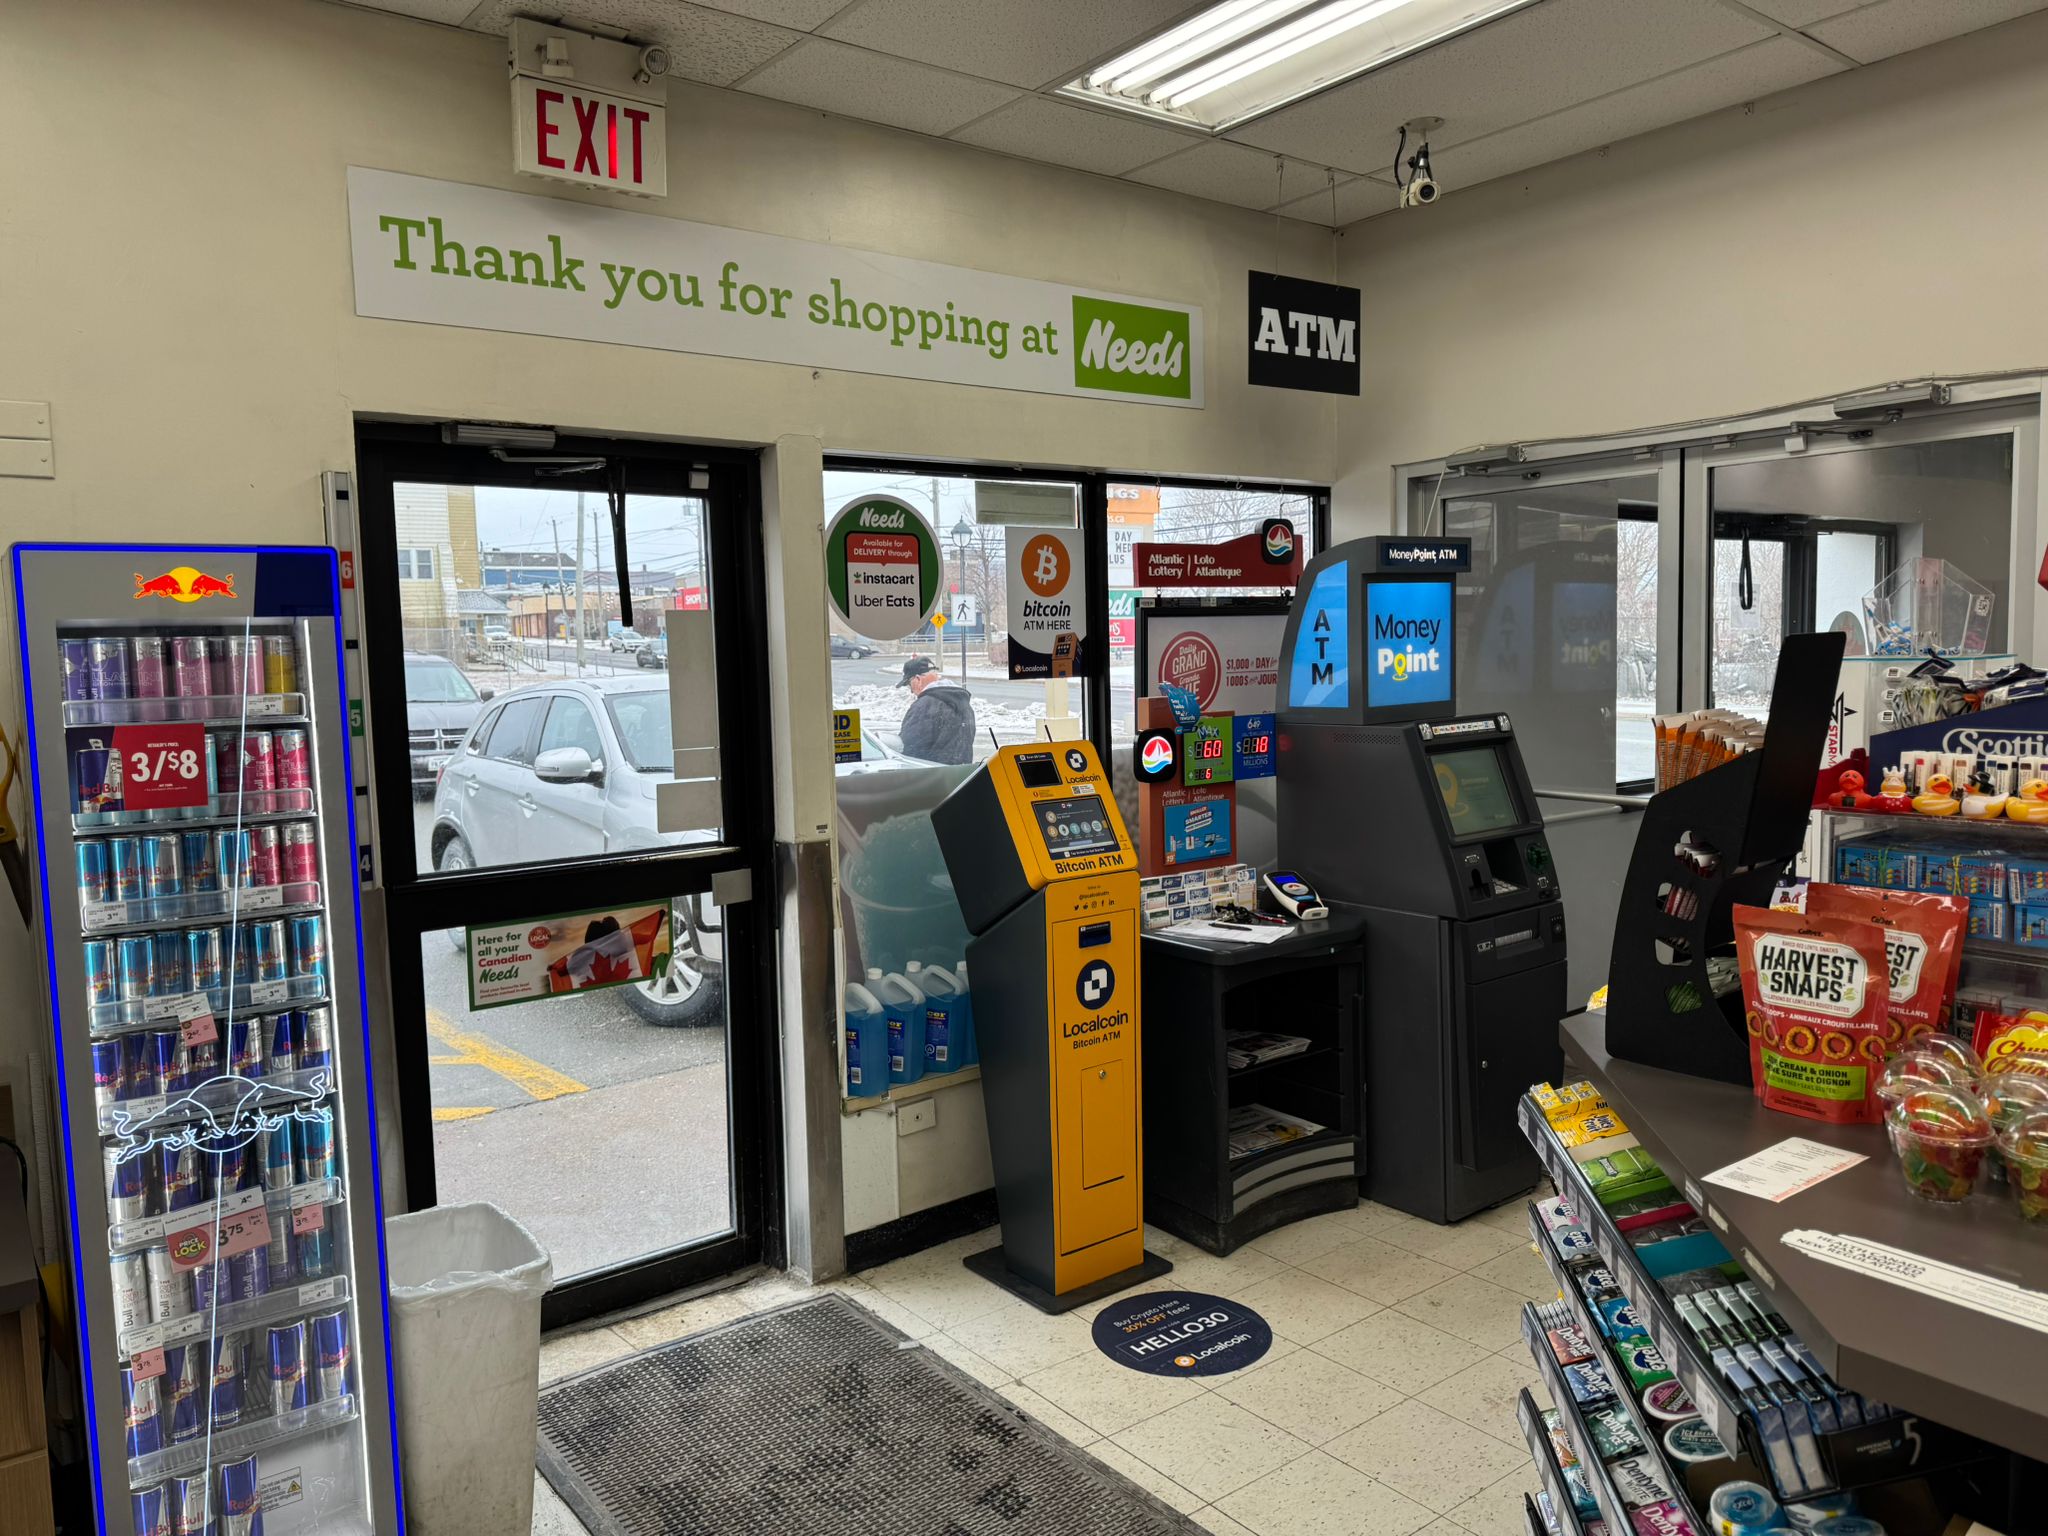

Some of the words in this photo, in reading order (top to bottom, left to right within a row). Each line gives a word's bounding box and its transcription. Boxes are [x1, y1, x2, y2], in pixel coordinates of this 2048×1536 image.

[536, 88, 650, 184] EXIT
[379, 215, 585, 292] Thank
[600, 260, 704, 309] you
[718, 262, 793, 320] for
[808, 277, 1010, 359] shopping
[1021, 322, 1058, 355] at
[1254, 307, 1356, 363] ATM
[1080, 317, 1183, 379] Needs
[860, 508, 905, 528] Needs
[863, 539, 892, 547] Available
[854, 548, 885, 556] DELIVERY
[888, 550, 912, 558] through
[1149, 554, 1184, 564] Atlantic
[1194, 554, 1215, 565] Loto
[1439, 549, 1457, 559] ATM
[341, 561, 352, 579] 6
[863, 572, 914, 584] instacart
[1149, 566, 1183, 579] Lottery
[1195, 567, 1242, 579] Atlantique
[854, 595, 884, 607] Uber
[886, 595, 915, 607] Eats
[1023, 600, 1071, 617] bitcoin
[1024, 620, 1044, 630] ATM
[1047, 620, 1071, 630] HERE
[1375, 614, 1440, 645] Money
[1180, 644, 1197, 655] Daily
[1312, 609, 1333, 685] ATM
[1022, 664, 1048, 672] Localcoin
[1172, 650, 1207, 675] GRAND
[1226, 659, 1249, 670] $1,000
[1255, 657, 1270, 669] DAY
[1378, 645, 1439, 678] Point
[1257, 674, 1277, 685] JOUR
[351, 709, 361, 726] 5
[1198, 726, 1219, 739] MAX
[1203, 740, 1222, 758] 60
[1255, 736, 1269, 753] 18
[1944, 729, 2048, 756] Scotti
[131, 749, 199, 782] 3/$8
[1205, 768, 1212, 779] 6
[1065, 774, 1101, 784] Localcoin
[1162, 790, 1186, 798] Atlantic
[361, 855, 371, 873] 4
[1055, 859, 1096, 874] Bitcoin
[1099, 854, 1124, 868] ATM
[477, 935, 503, 946] Here
[506, 932, 522, 943] for
[530, 935, 549, 943] LOCAL
[477, 946, 492, 957] all
[495, 944, 520, 957] your
[478, 952, 533, 968] Canadian
[1761, 945, 1858, 984] HARVEST
[479, 965, 520, 983] Needs
[1770, 972, 1842, 1003] SNAPS
[1063, 1010, 1129, 1038] Localcoin
[1789, 1013, 1822, 1024] ANNEAUX
[1822, 1019, 1879, 1031] CROUSTILLANTS
[1073, 1034, 1101, 1050] Bitcoin
[1102, 1030, 1120, 1042] ATM
[1779, 1061, 1807, 1073] CREAM
[1818, 1069, 1848, 1078] ONION
[1782, 1069, 1803, 1080] SURE
[1816, 1077, 1851, 1087] OIGNON
[174, 1242, 207, 1258] LOCK
[179, 1237, 200, 1249] PRICE
[1797, 1238, 1825, 1249] NEW
[1827, 1248, 1917, 1278] REGULATIONS
[1817, 1235, 1867, 1255] HEALTH
[1870, 1251, 1926, 1272] CANADA
[1829, 1243, 1854, 1256] HAS
[1859, 1252, 1923, 1275] ADOPTED
[1594, 1269, 1618, 1288] excel
[1113, 1318, 1131, 1329] Buy
[1130, 1307, 1159, 1322] Crypto
[1158, 1299, 1180, 1310] Here
[1122, 1319, 1147, 1334] 30%
[1147, 1313, 1167, 1325] OFF
[1130, 1312, 1230, 1355] HELLO30
[1558, 1327, 1595, 1355] Dentyne
[1190, 1332, 1252, 1360] Localcoin
[1634, 1347, 1668, 1370] excel
[1575, 1362, 1614, 1392] Dentyne
[1585, 1384, 1598, 1393] ICE
[1596, 1410, 1642, 1444] Dentyne
[1609, 1436, 1624, 1446] ICE
[1904, 1418, 1922, 1465] 5
[1620, 1460, 1669, 1499] Dentyne
